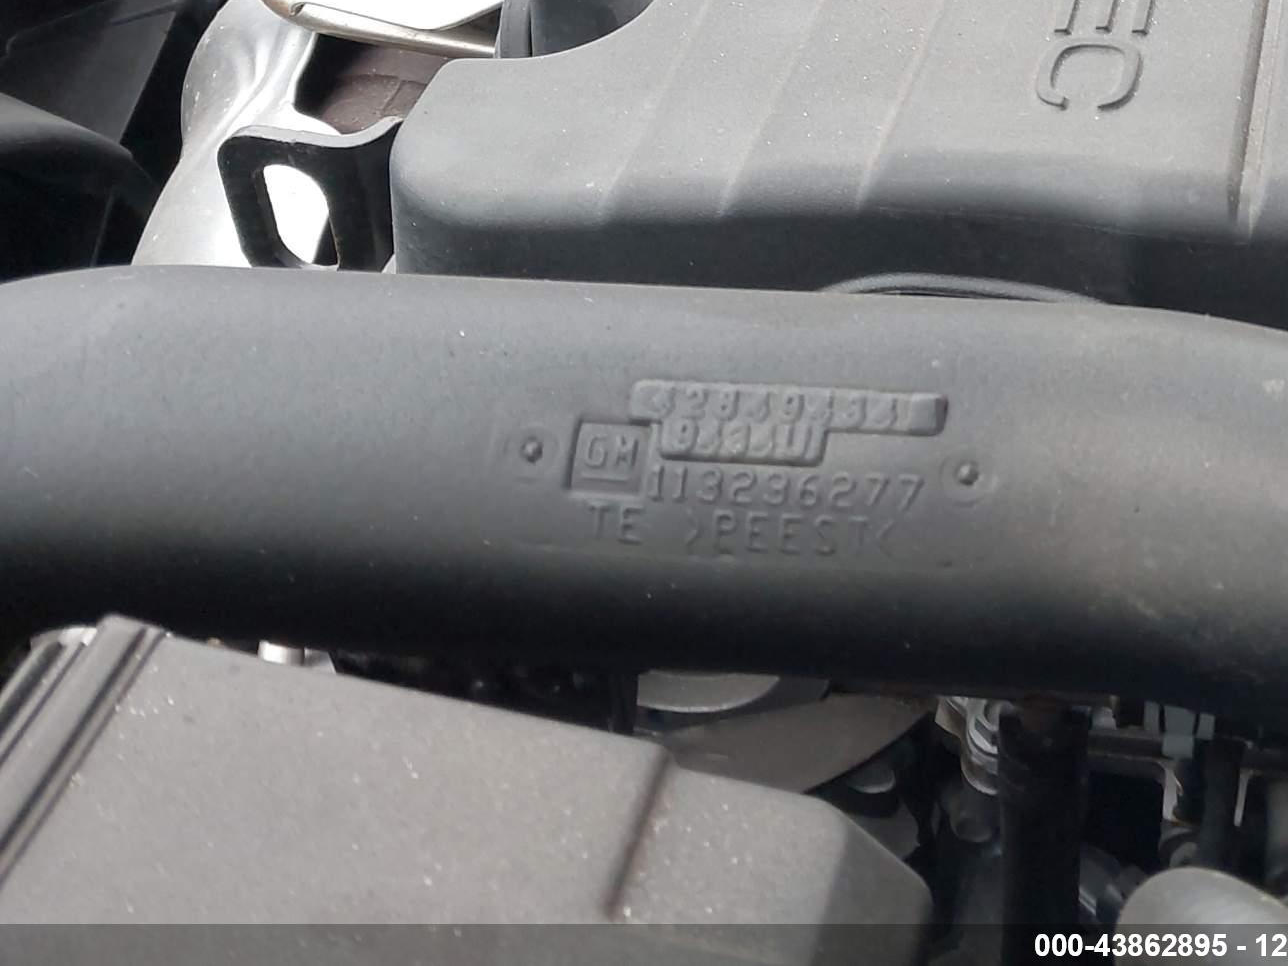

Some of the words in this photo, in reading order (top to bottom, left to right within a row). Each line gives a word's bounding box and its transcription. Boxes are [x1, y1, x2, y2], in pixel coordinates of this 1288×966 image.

[583, 434, 639, 469] GM
[649, 464, 925, 510] 113236277
[587, 501, 644, 546] TE
